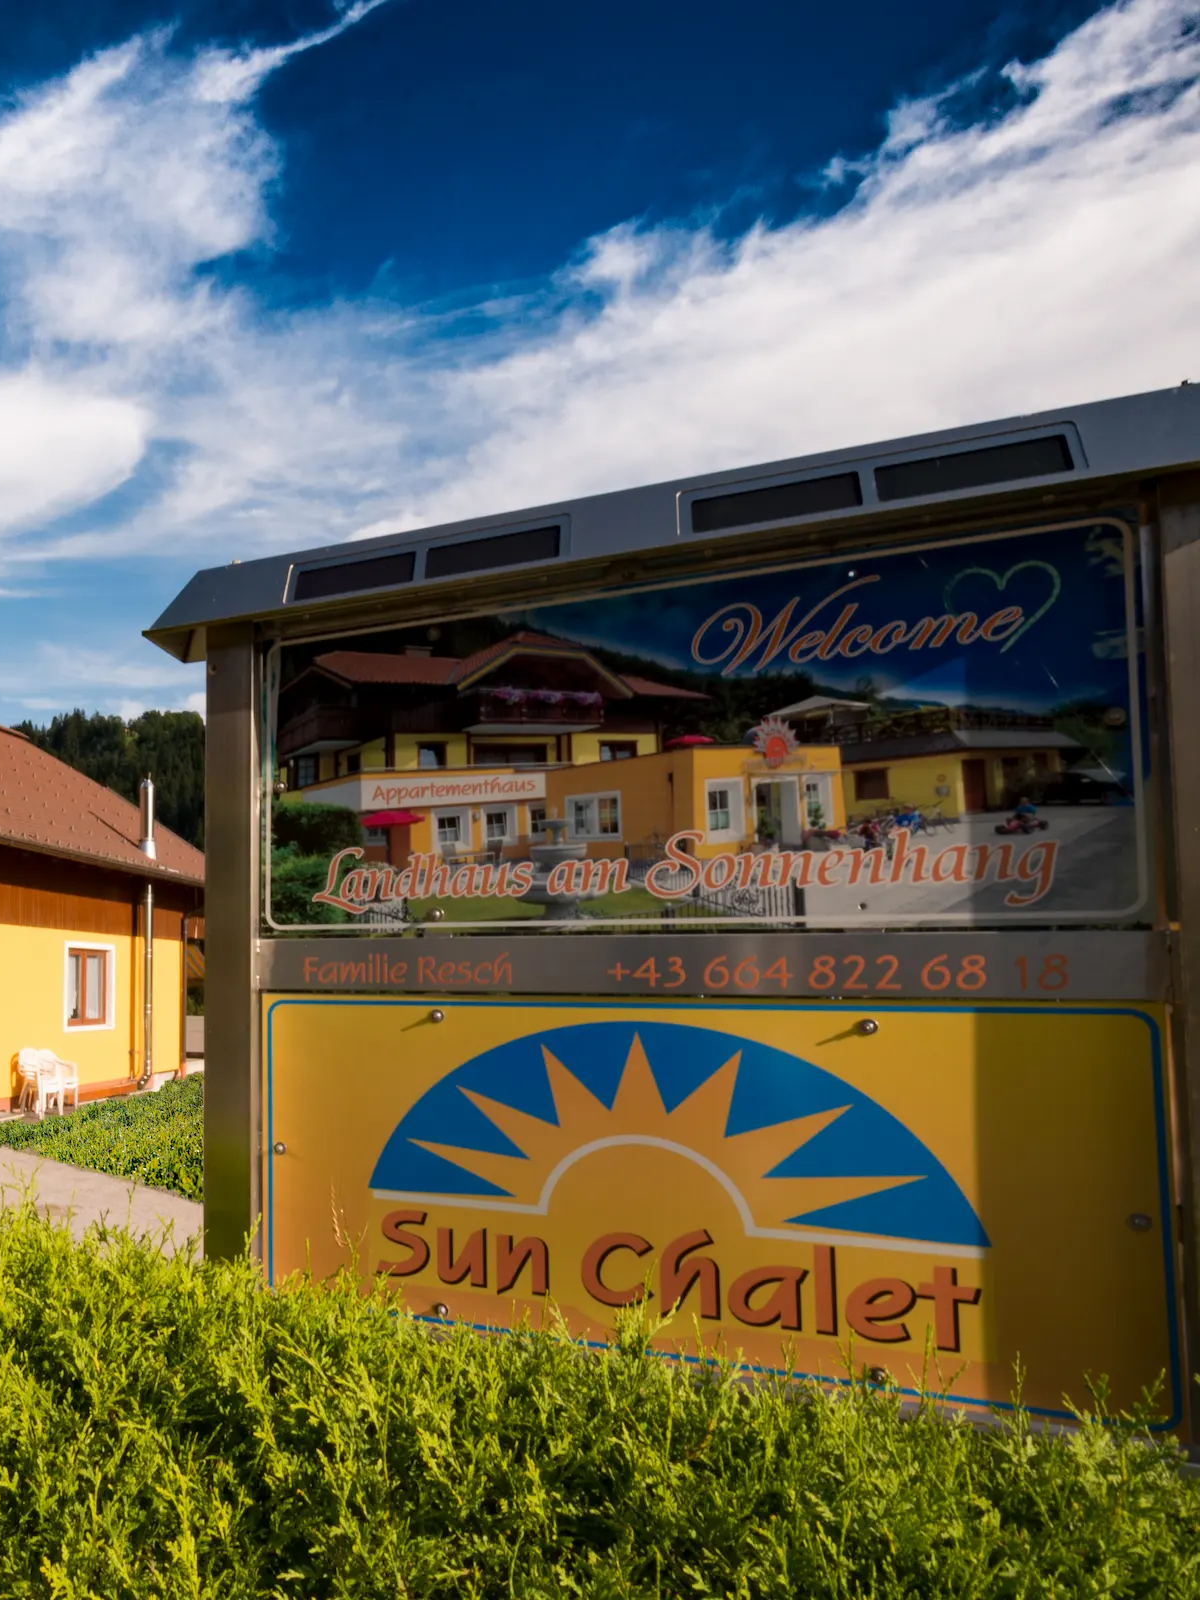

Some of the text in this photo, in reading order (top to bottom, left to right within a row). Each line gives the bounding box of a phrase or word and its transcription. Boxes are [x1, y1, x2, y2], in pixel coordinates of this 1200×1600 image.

[691, 575, 1025, 676] Welcome
[371, 776, 537, 802] Appartementhaus
[312, 829, 1059, 915] Landhaus am Sonnenhang
[303, 952, 1071, 990] Familie Resch +43 664 822 68 18
[375, 1209, 982, 1353] Sun Chalet
